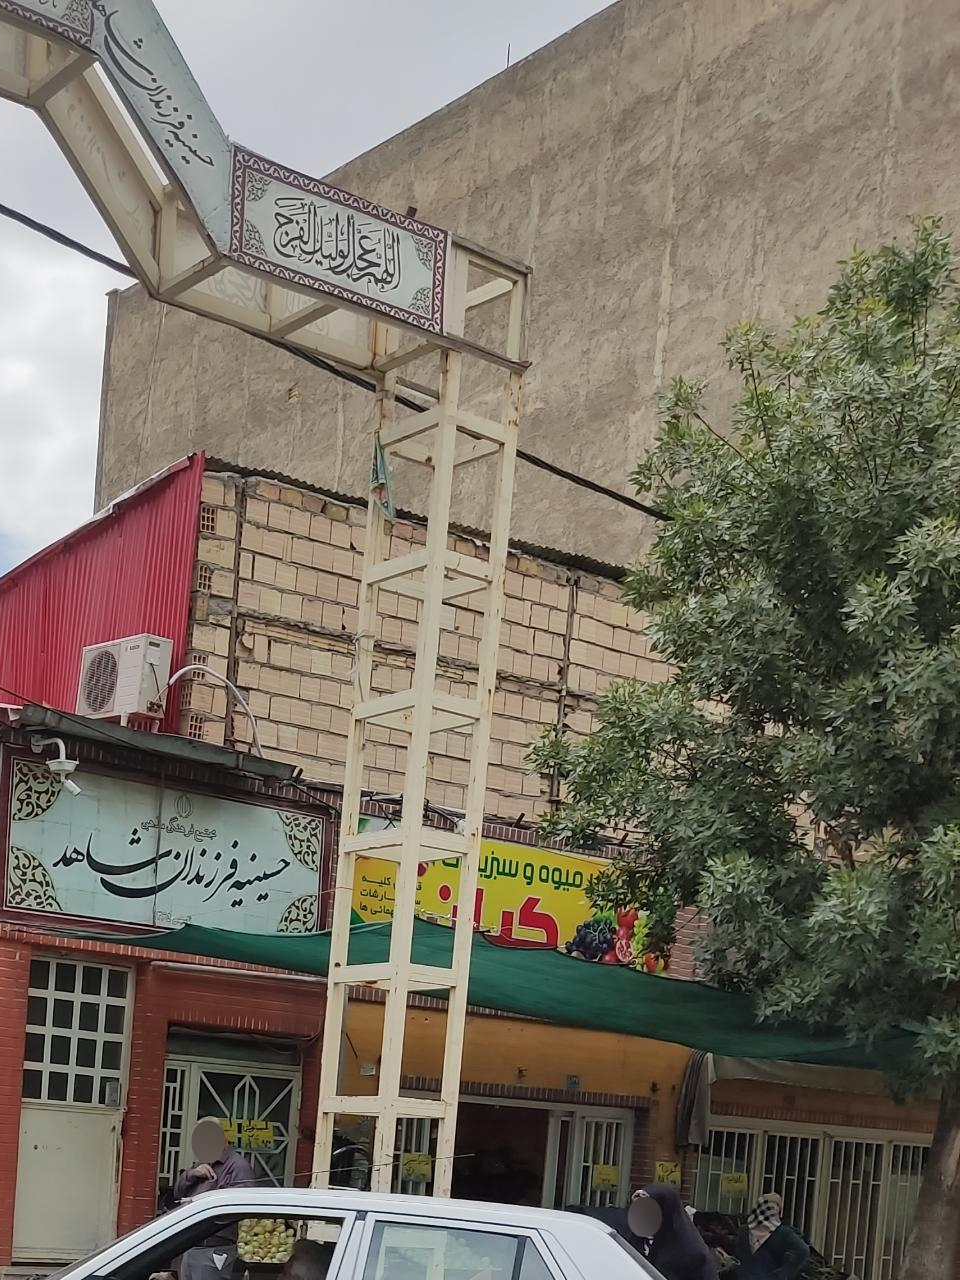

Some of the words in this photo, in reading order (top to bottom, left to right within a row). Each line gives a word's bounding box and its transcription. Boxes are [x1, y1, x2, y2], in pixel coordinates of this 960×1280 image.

[103, 34, 192, 129] فرزندان
[164, 130, 214, 166] حسینیه
[52, 828, 173, 876] شاهد
[100, 840, 240, 903] فرزندان
[227, 852, 290, 908] حسینیه
[361, 875, 392, 888] کلیه
[523, 862, 535, 886] و
[539, 865, 583, 892] میوه
[360, 889, 421, 905] سارشات
